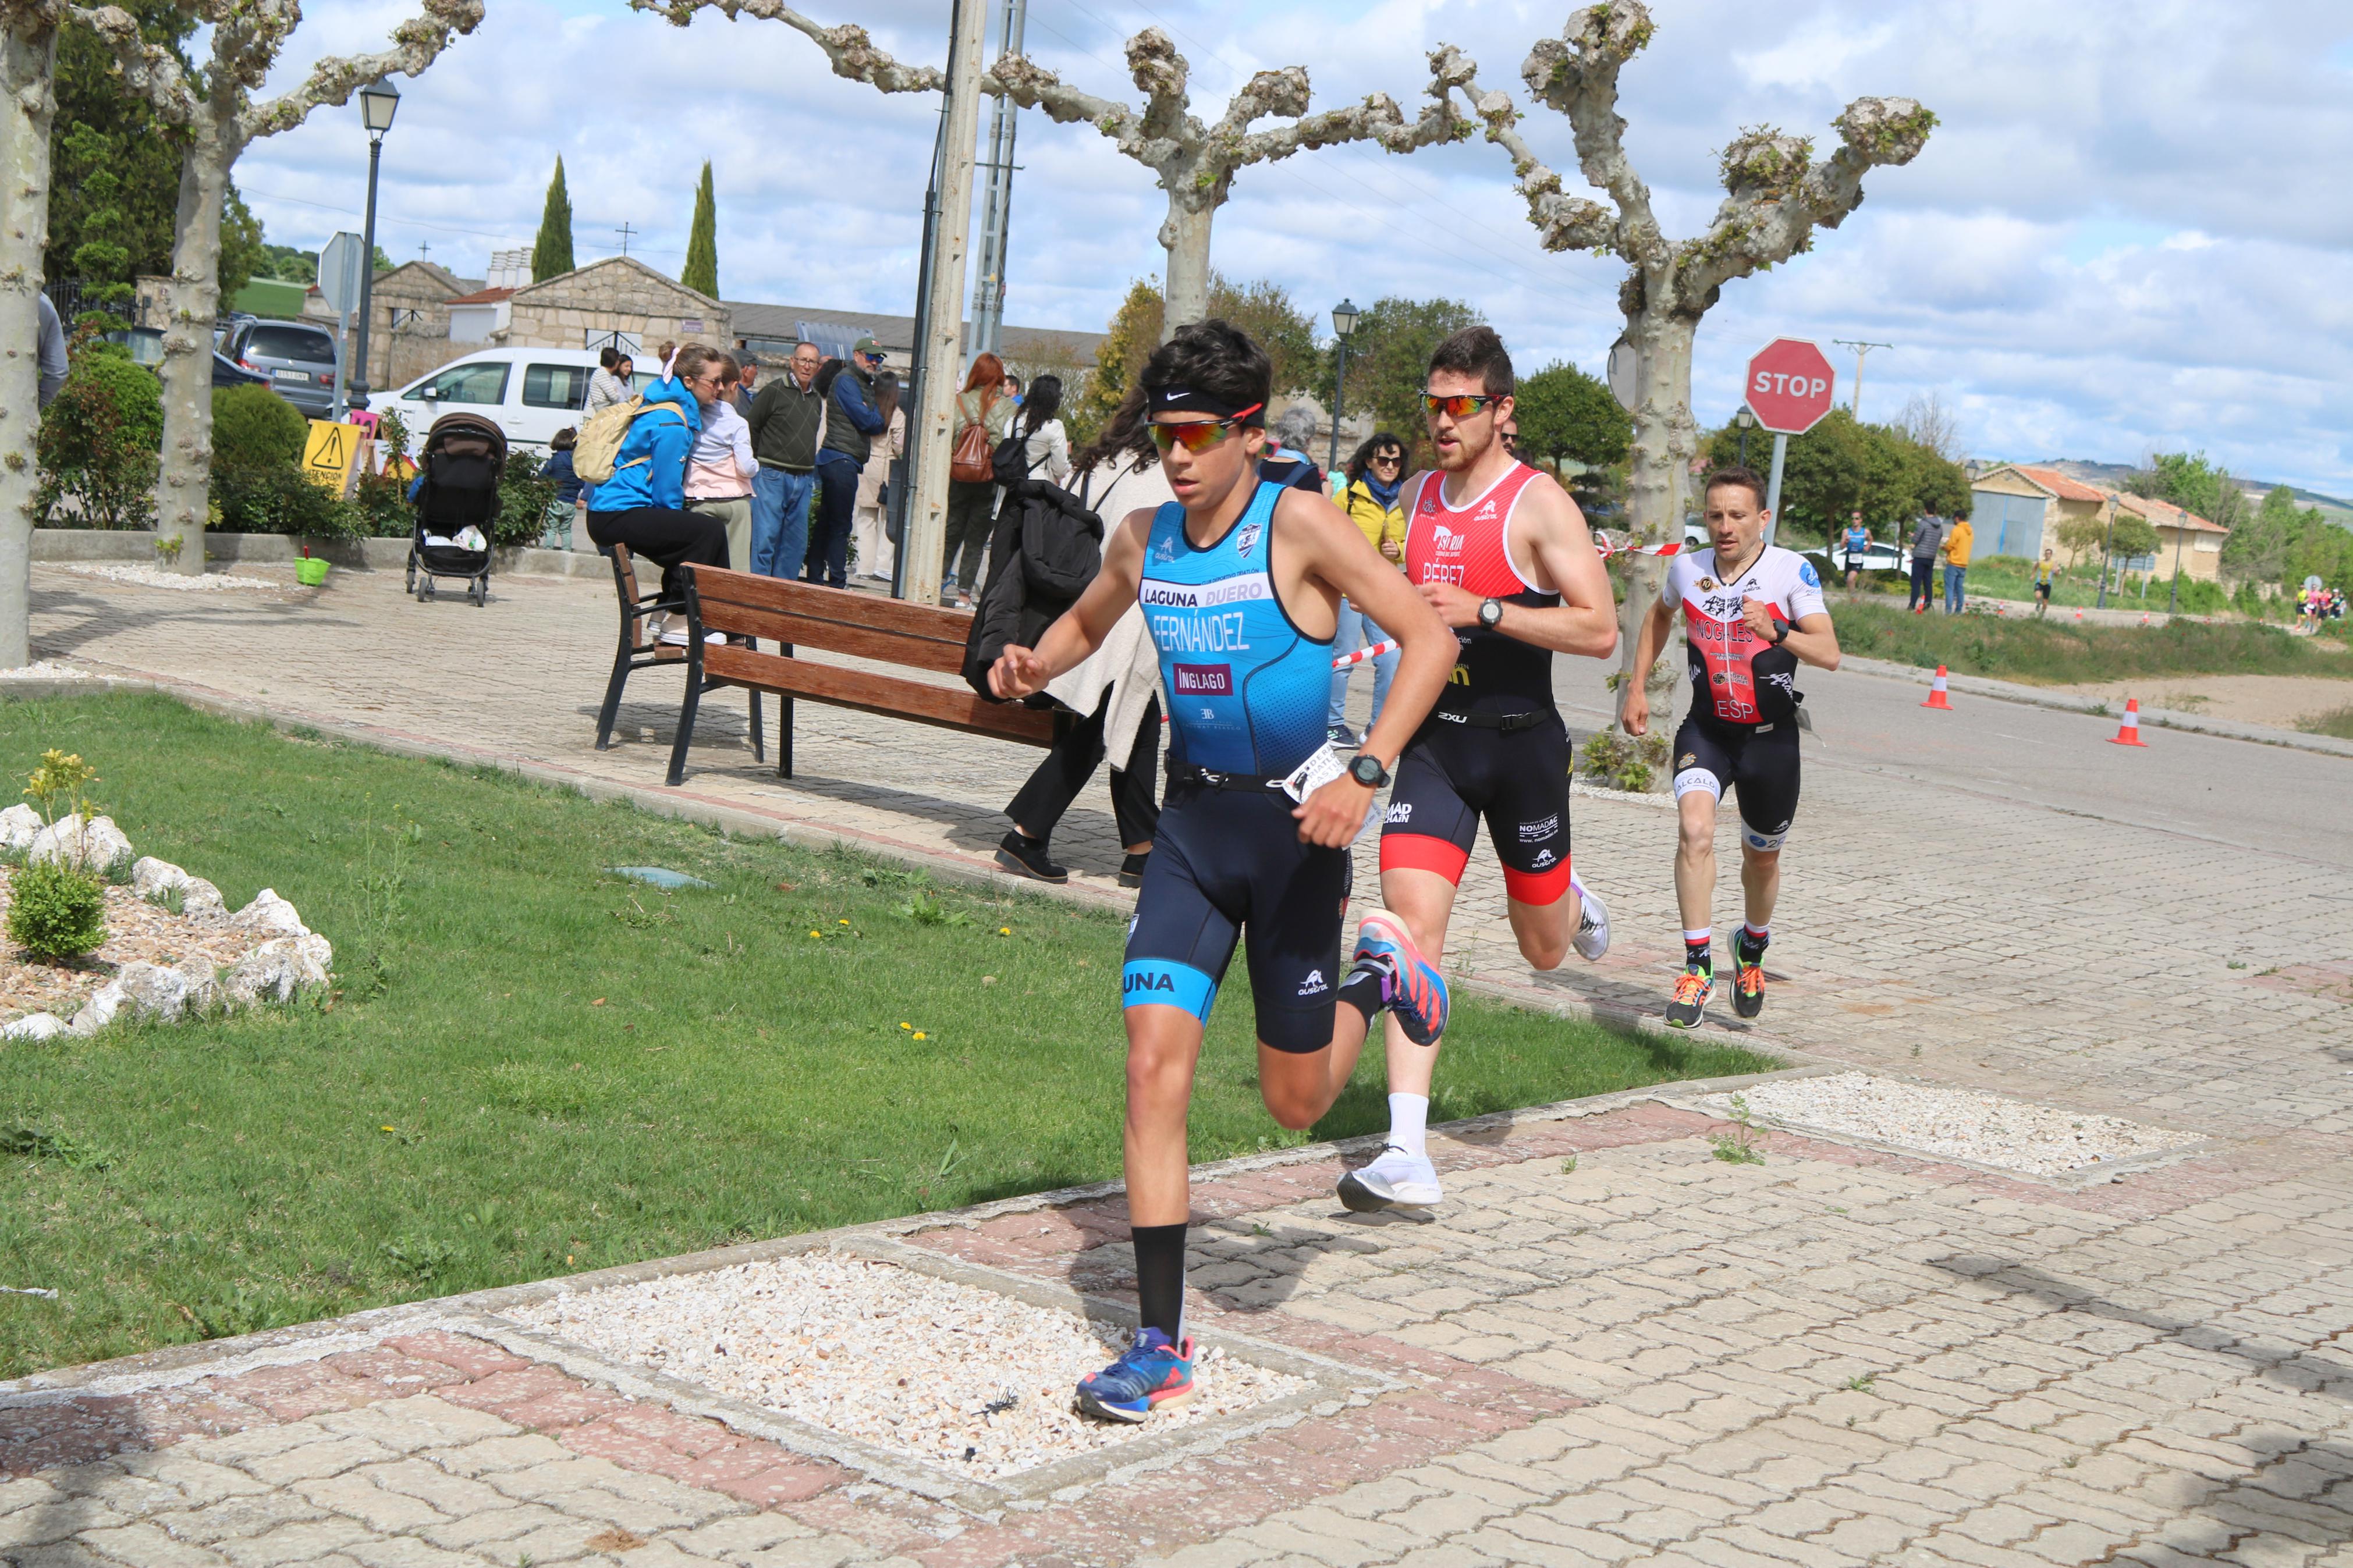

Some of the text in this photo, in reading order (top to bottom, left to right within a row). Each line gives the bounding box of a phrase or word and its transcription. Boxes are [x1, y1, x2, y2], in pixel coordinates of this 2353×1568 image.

[1754, 371, 1826, 399] STOP
[1237, 567, 1259, 576] TRIATLÓN
[1145, 589, 1198, 607] LAGUNA
[1154, 609, 1250, 652] FERNÁNDEZ
[1696, 618, 1753, 643] NOGALES
[1179, 668, 1225, 689] INGLAGO
[1438, 712, 1468, 724] 2XU
[1717, 699, 1754, 719] ESP
[1386, 801, 1412, 817] MAD
[1520, 816, 1557, 832] NOMADAC
[1531, 856, 1557, 868] austral
[1123, 972, 1174, 994] UNA
[1298, 983, 1328, 995] austral
